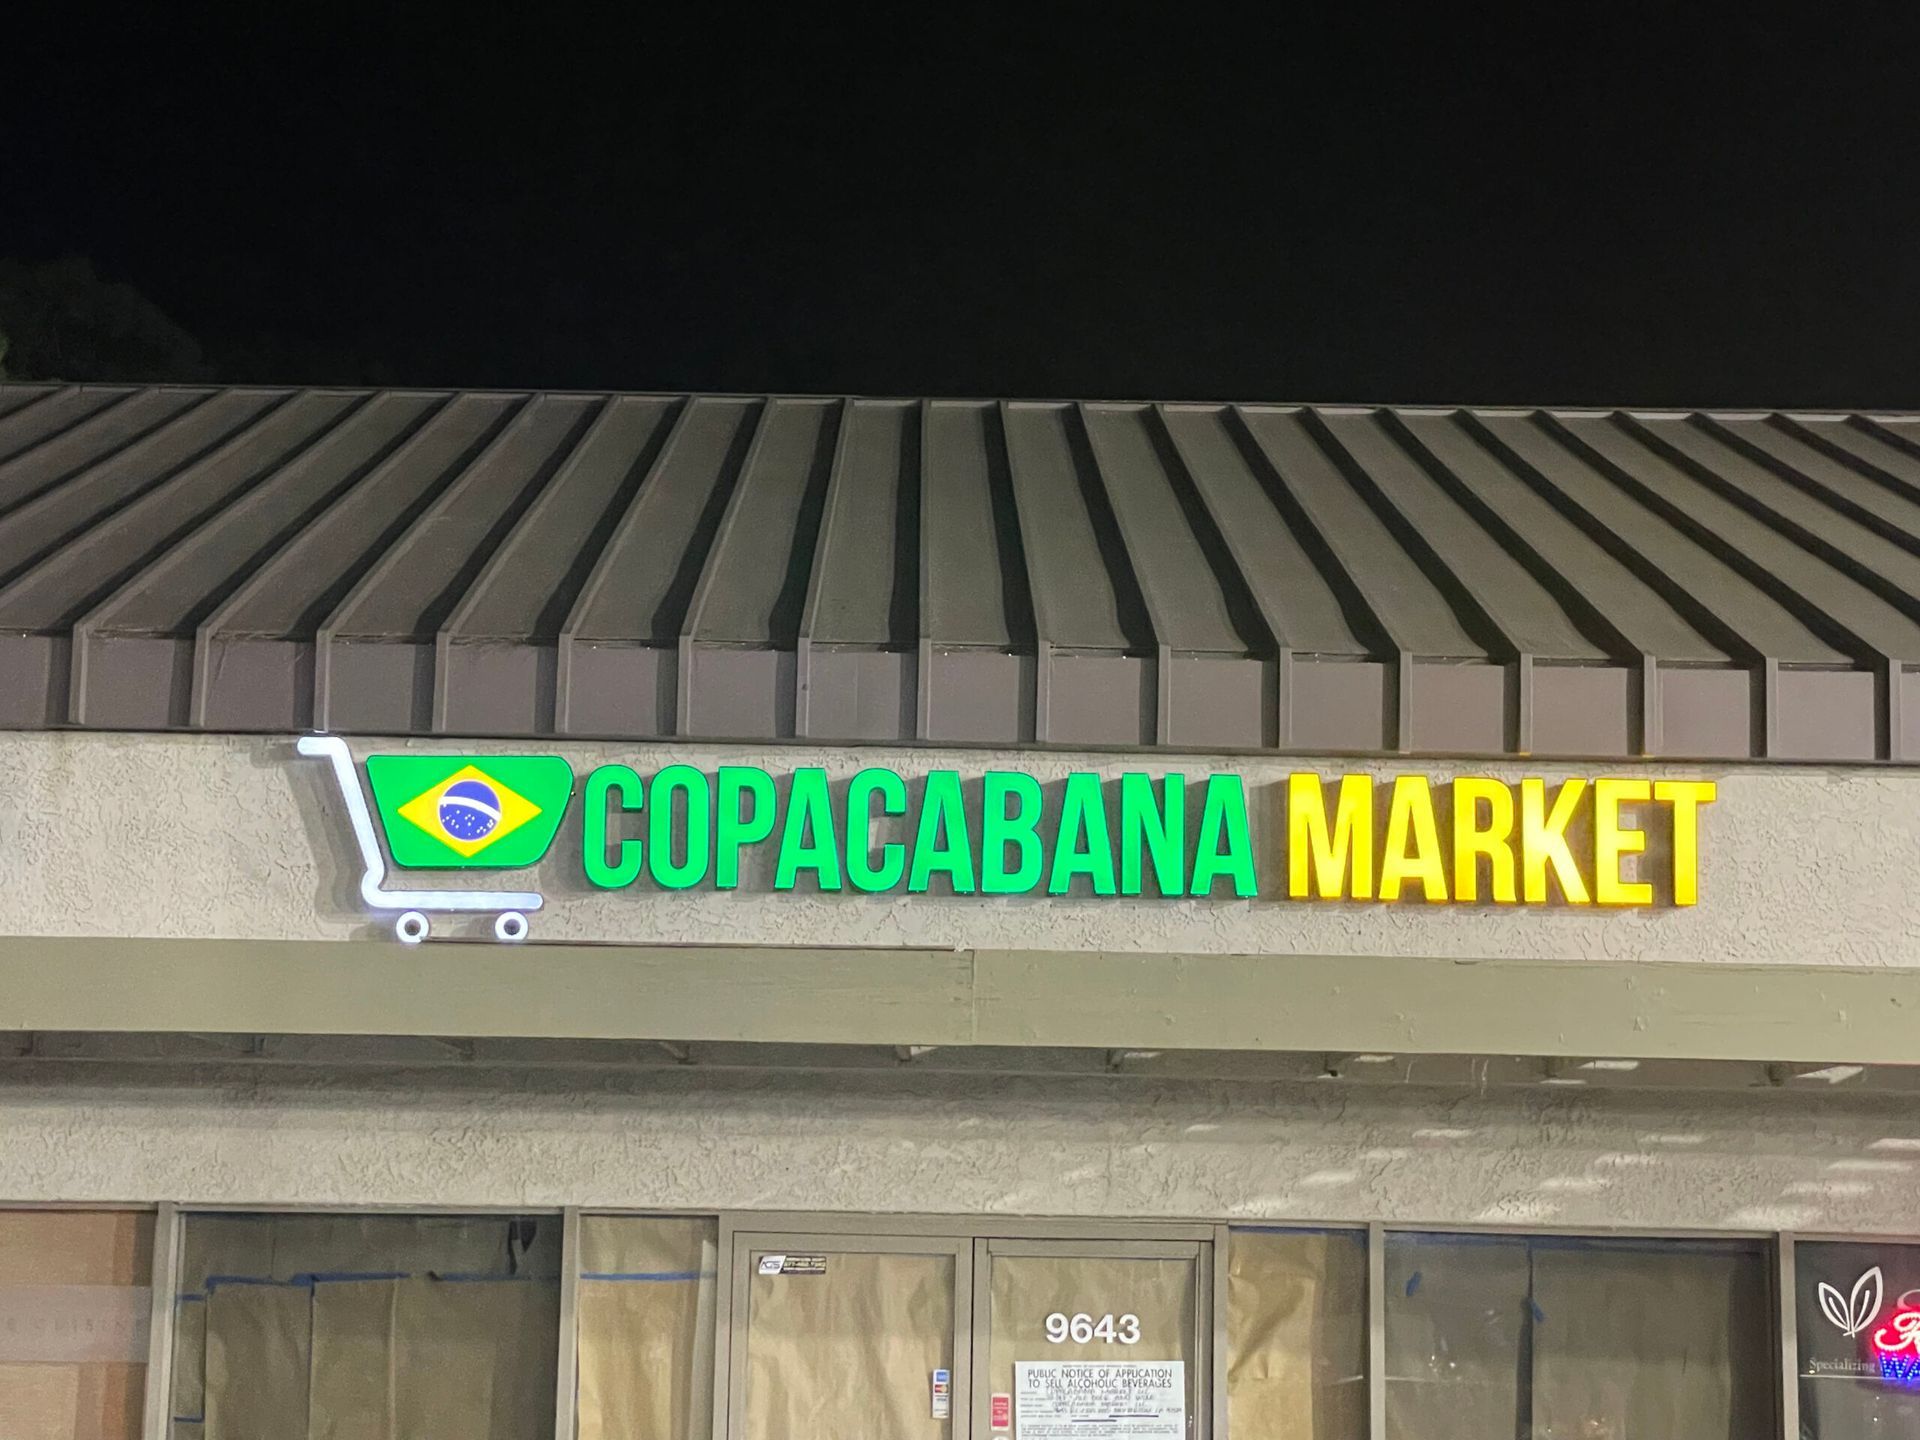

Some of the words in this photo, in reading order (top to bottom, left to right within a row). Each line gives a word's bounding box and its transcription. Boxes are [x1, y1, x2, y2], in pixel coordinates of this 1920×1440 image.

[583, 764, 1258, 898] COPACABANA
[1288, 773, 1718, 907] MARKET
[1045, 1312, 1141, 1344] 9643
[1027, 1368, 1057, 1378] PUBLIC
[1061, 1368, 1094, 1378] NOTICE
[1098, 1368, 1110, 1378] OF
[1115, 1368, 1173, 1378] APPLICATION
[1809, 1357, 1876, 1373] Specializing
[1028, 1378, 1041, 1388] TO
[1045, 1378, 1063, 1388] SELL
[1067, 1378, 1118, 1388] ALCOHOLIC
[1121, 1378, 1172, 1388] BEVERAGES
